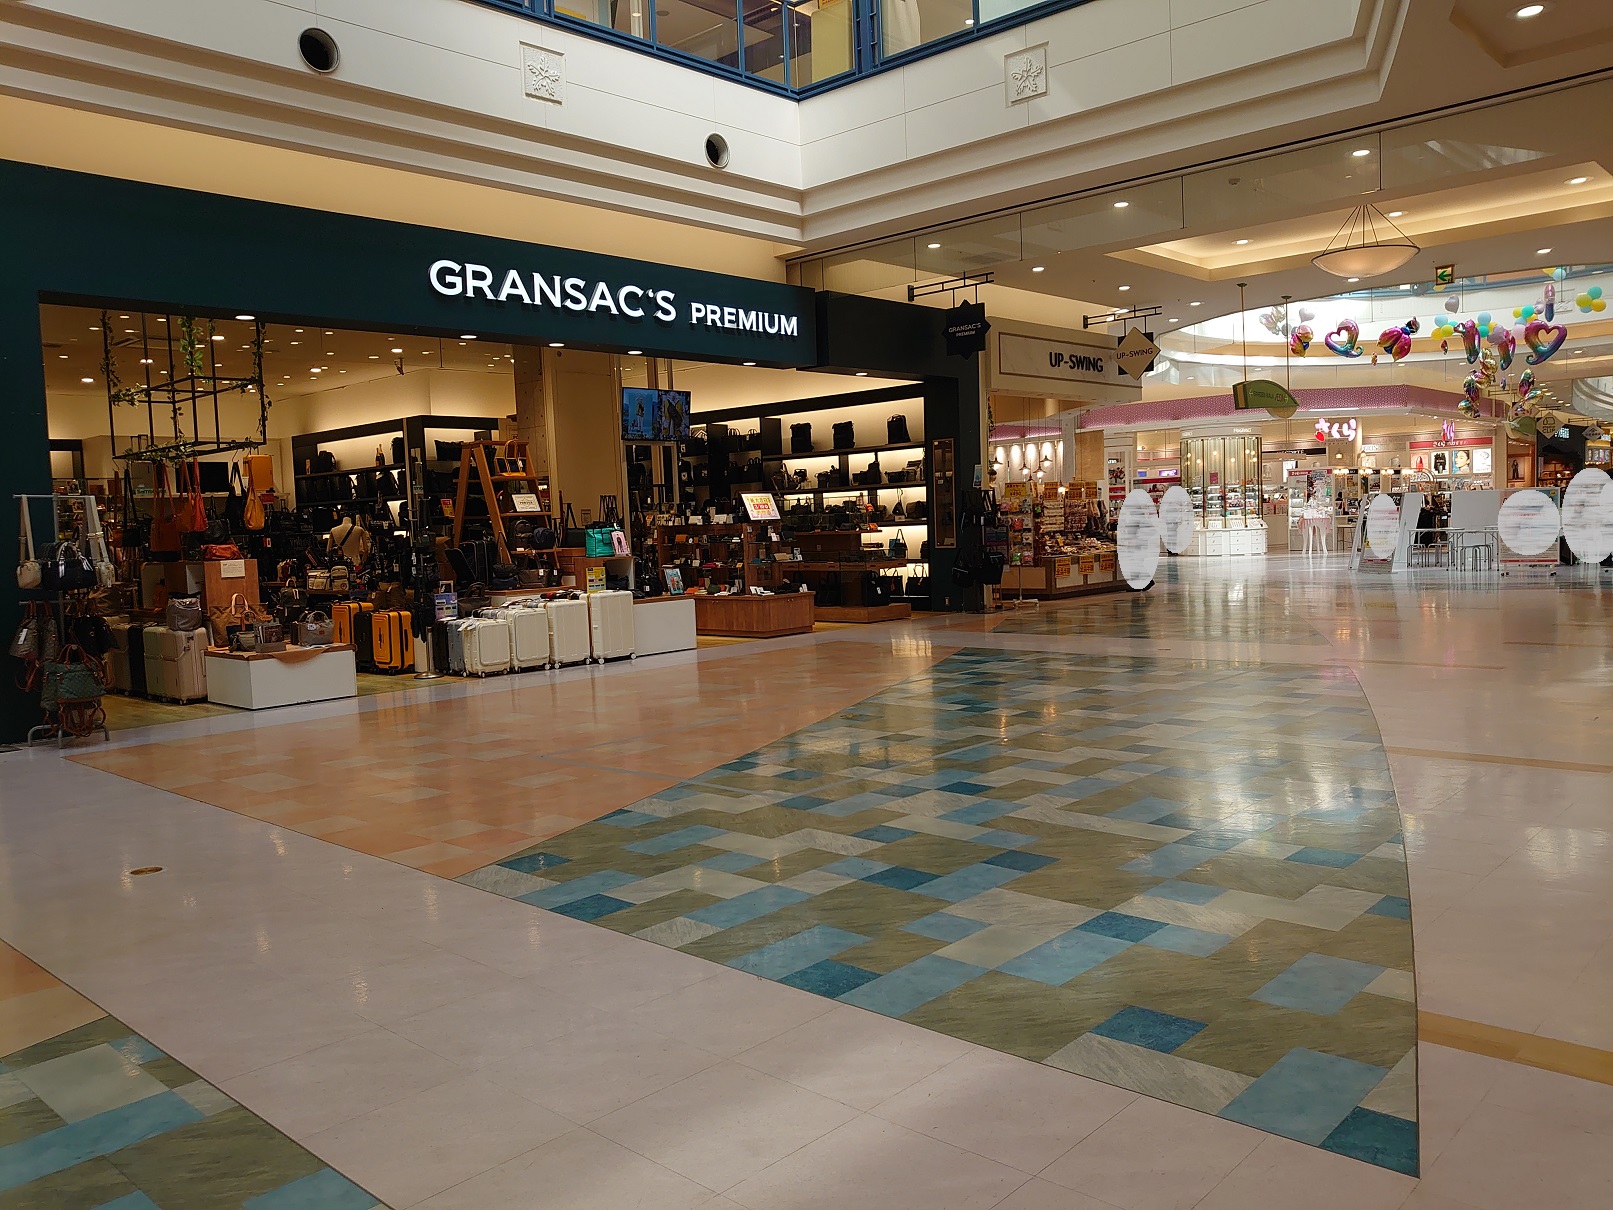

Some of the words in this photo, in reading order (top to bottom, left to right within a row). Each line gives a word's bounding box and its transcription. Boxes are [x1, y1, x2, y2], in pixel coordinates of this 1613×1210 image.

[428, 259, 677, 323] GRANSAC'S
[689, 302, 799, 337] PREMIUM
[1049, 351, 1104, 373] UP-SWING
[1116, 347, 1154, 360] UP-SWING
[1314, 417, 1357, 442] さくら
